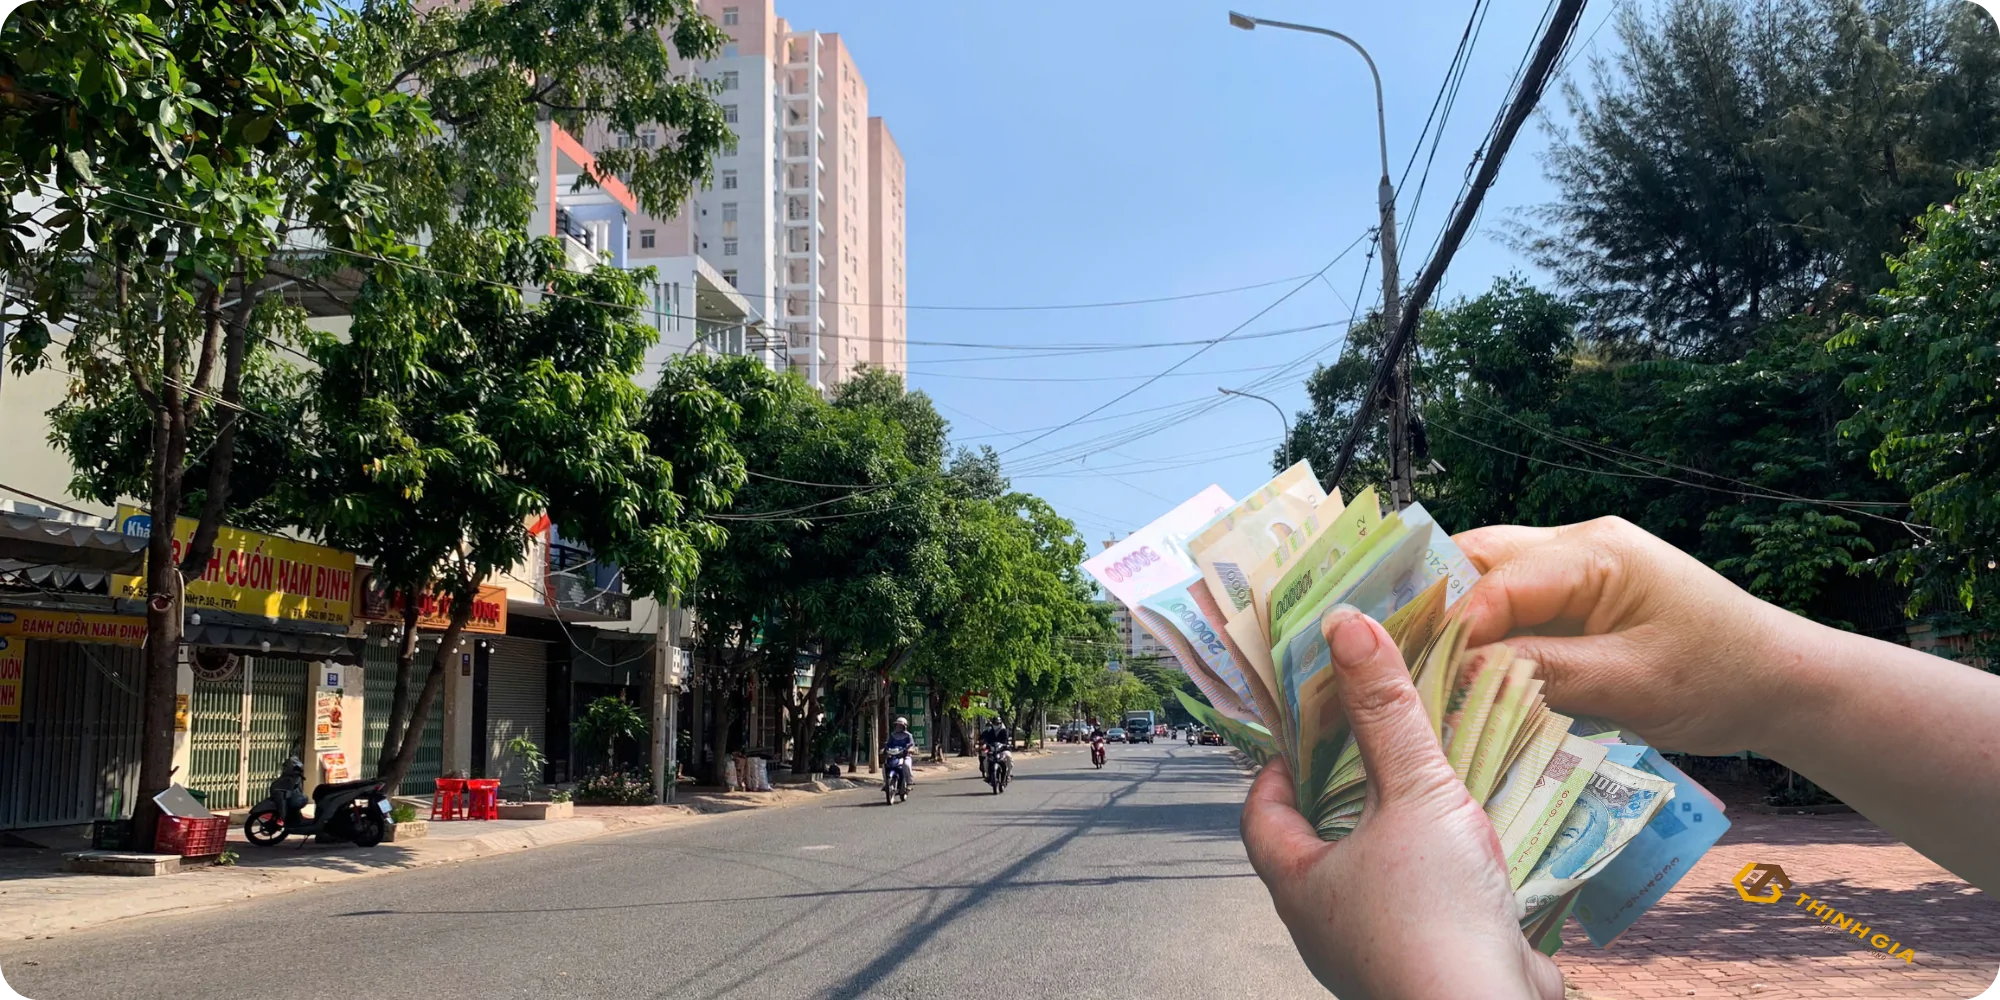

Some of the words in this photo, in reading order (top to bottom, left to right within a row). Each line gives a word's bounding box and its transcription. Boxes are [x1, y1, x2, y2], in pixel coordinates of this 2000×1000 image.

[225, 540, 274, 590] CUỐN
[278, 559, 313, 596] NAM
[315, 565, 352, 609] ĐỊNH
[91, 622, 118, 638] NAM
[0, 649, 21, 680] UỐN
